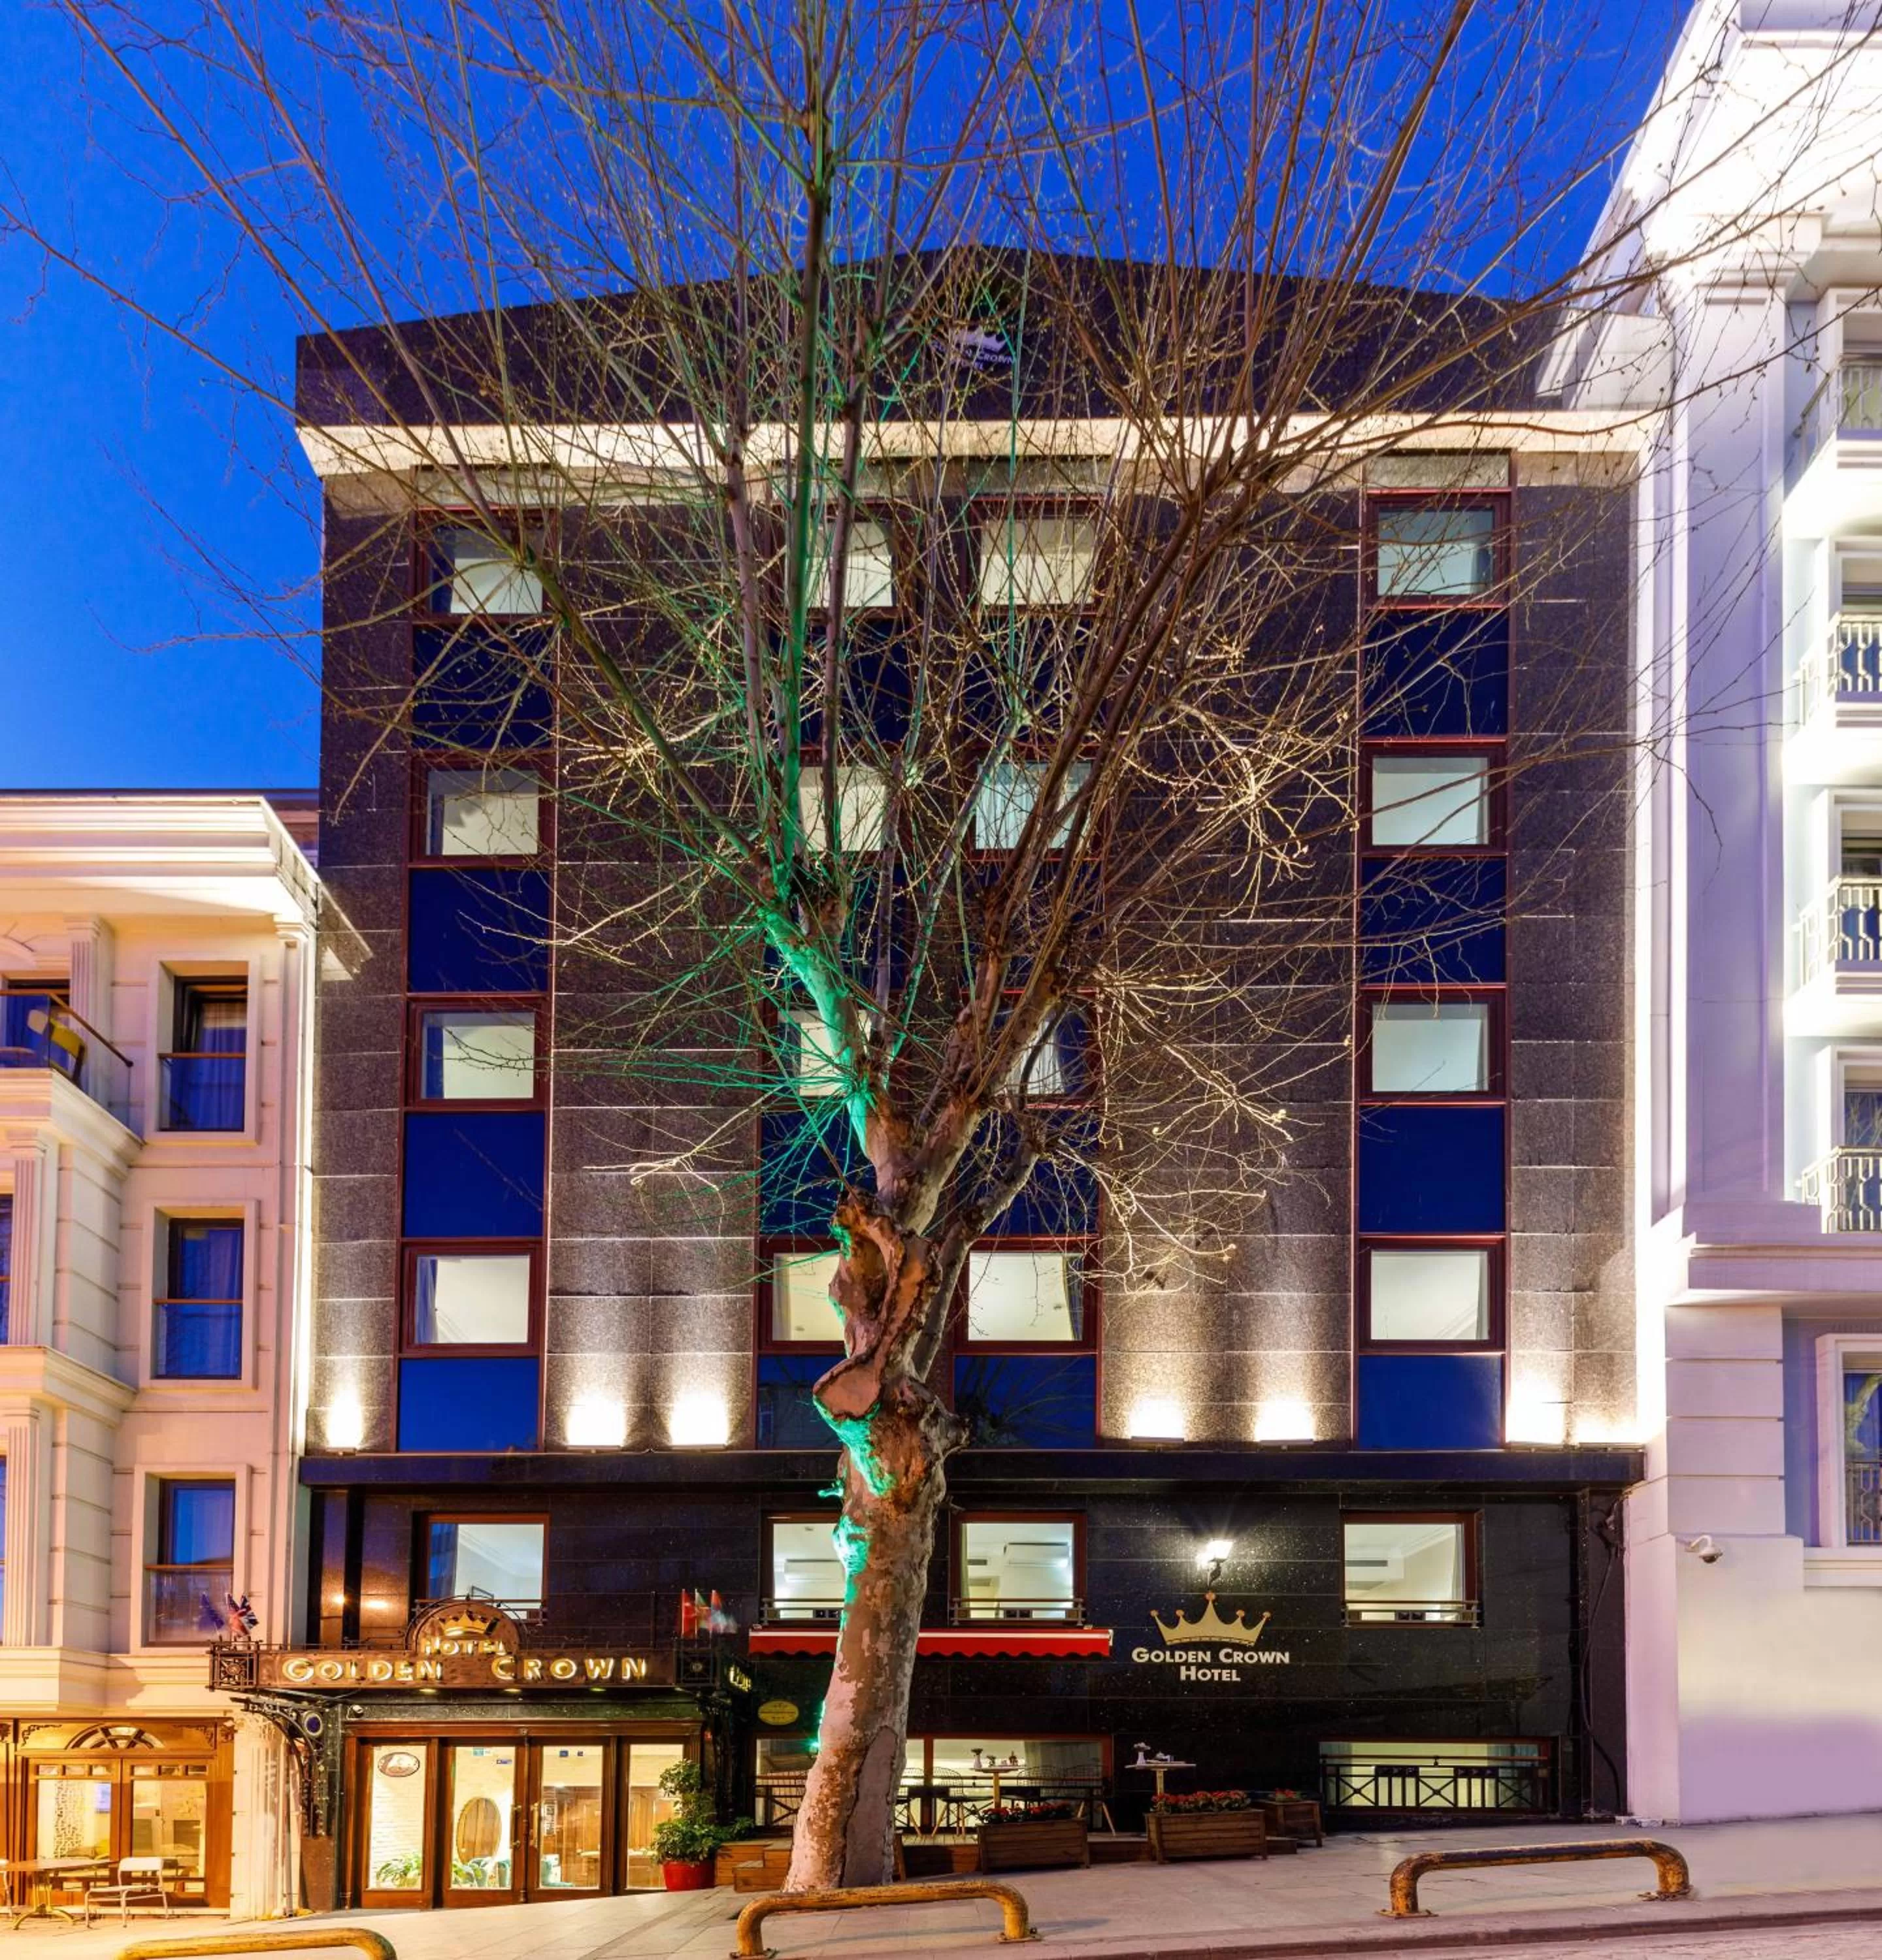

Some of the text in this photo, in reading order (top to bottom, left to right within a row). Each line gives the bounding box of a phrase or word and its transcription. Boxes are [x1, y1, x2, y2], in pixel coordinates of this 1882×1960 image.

[420, 1636, 506, 1656] HOTEL
[1131, 1647, 1290, 1664] GOLDEN CROWN
[282, 1655, 647, 1682] GOLDEN CROWN
[1180, 1665, 1241, 1682] HOTEL
